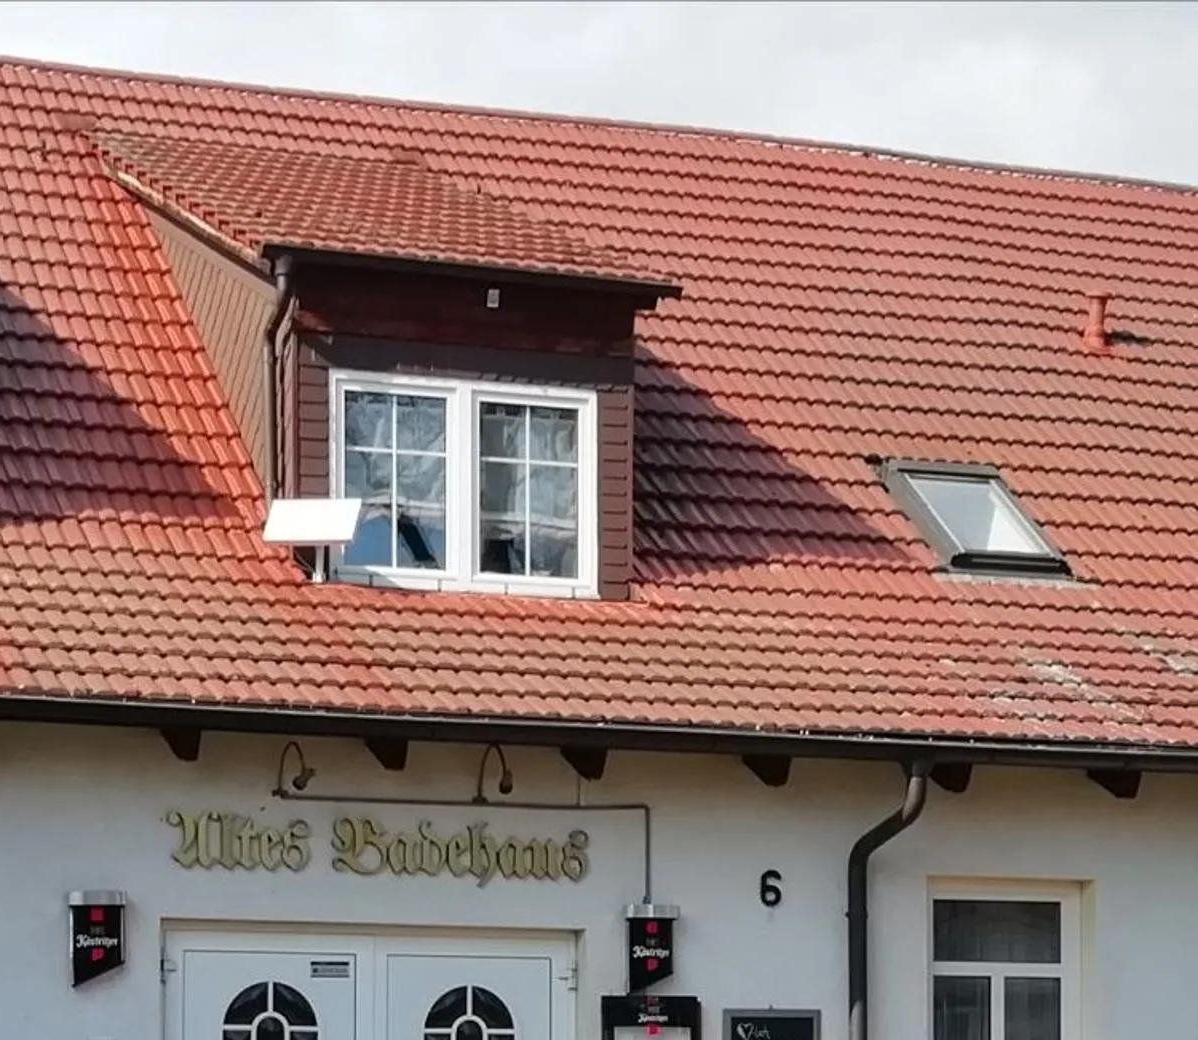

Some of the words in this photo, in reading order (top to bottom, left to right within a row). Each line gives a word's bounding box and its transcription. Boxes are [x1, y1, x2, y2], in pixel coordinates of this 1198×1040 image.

[163, 809, 312, 873] Altes
[330, 815, 592, 888] Badehaus
[760, 869, 782, 908] 6
